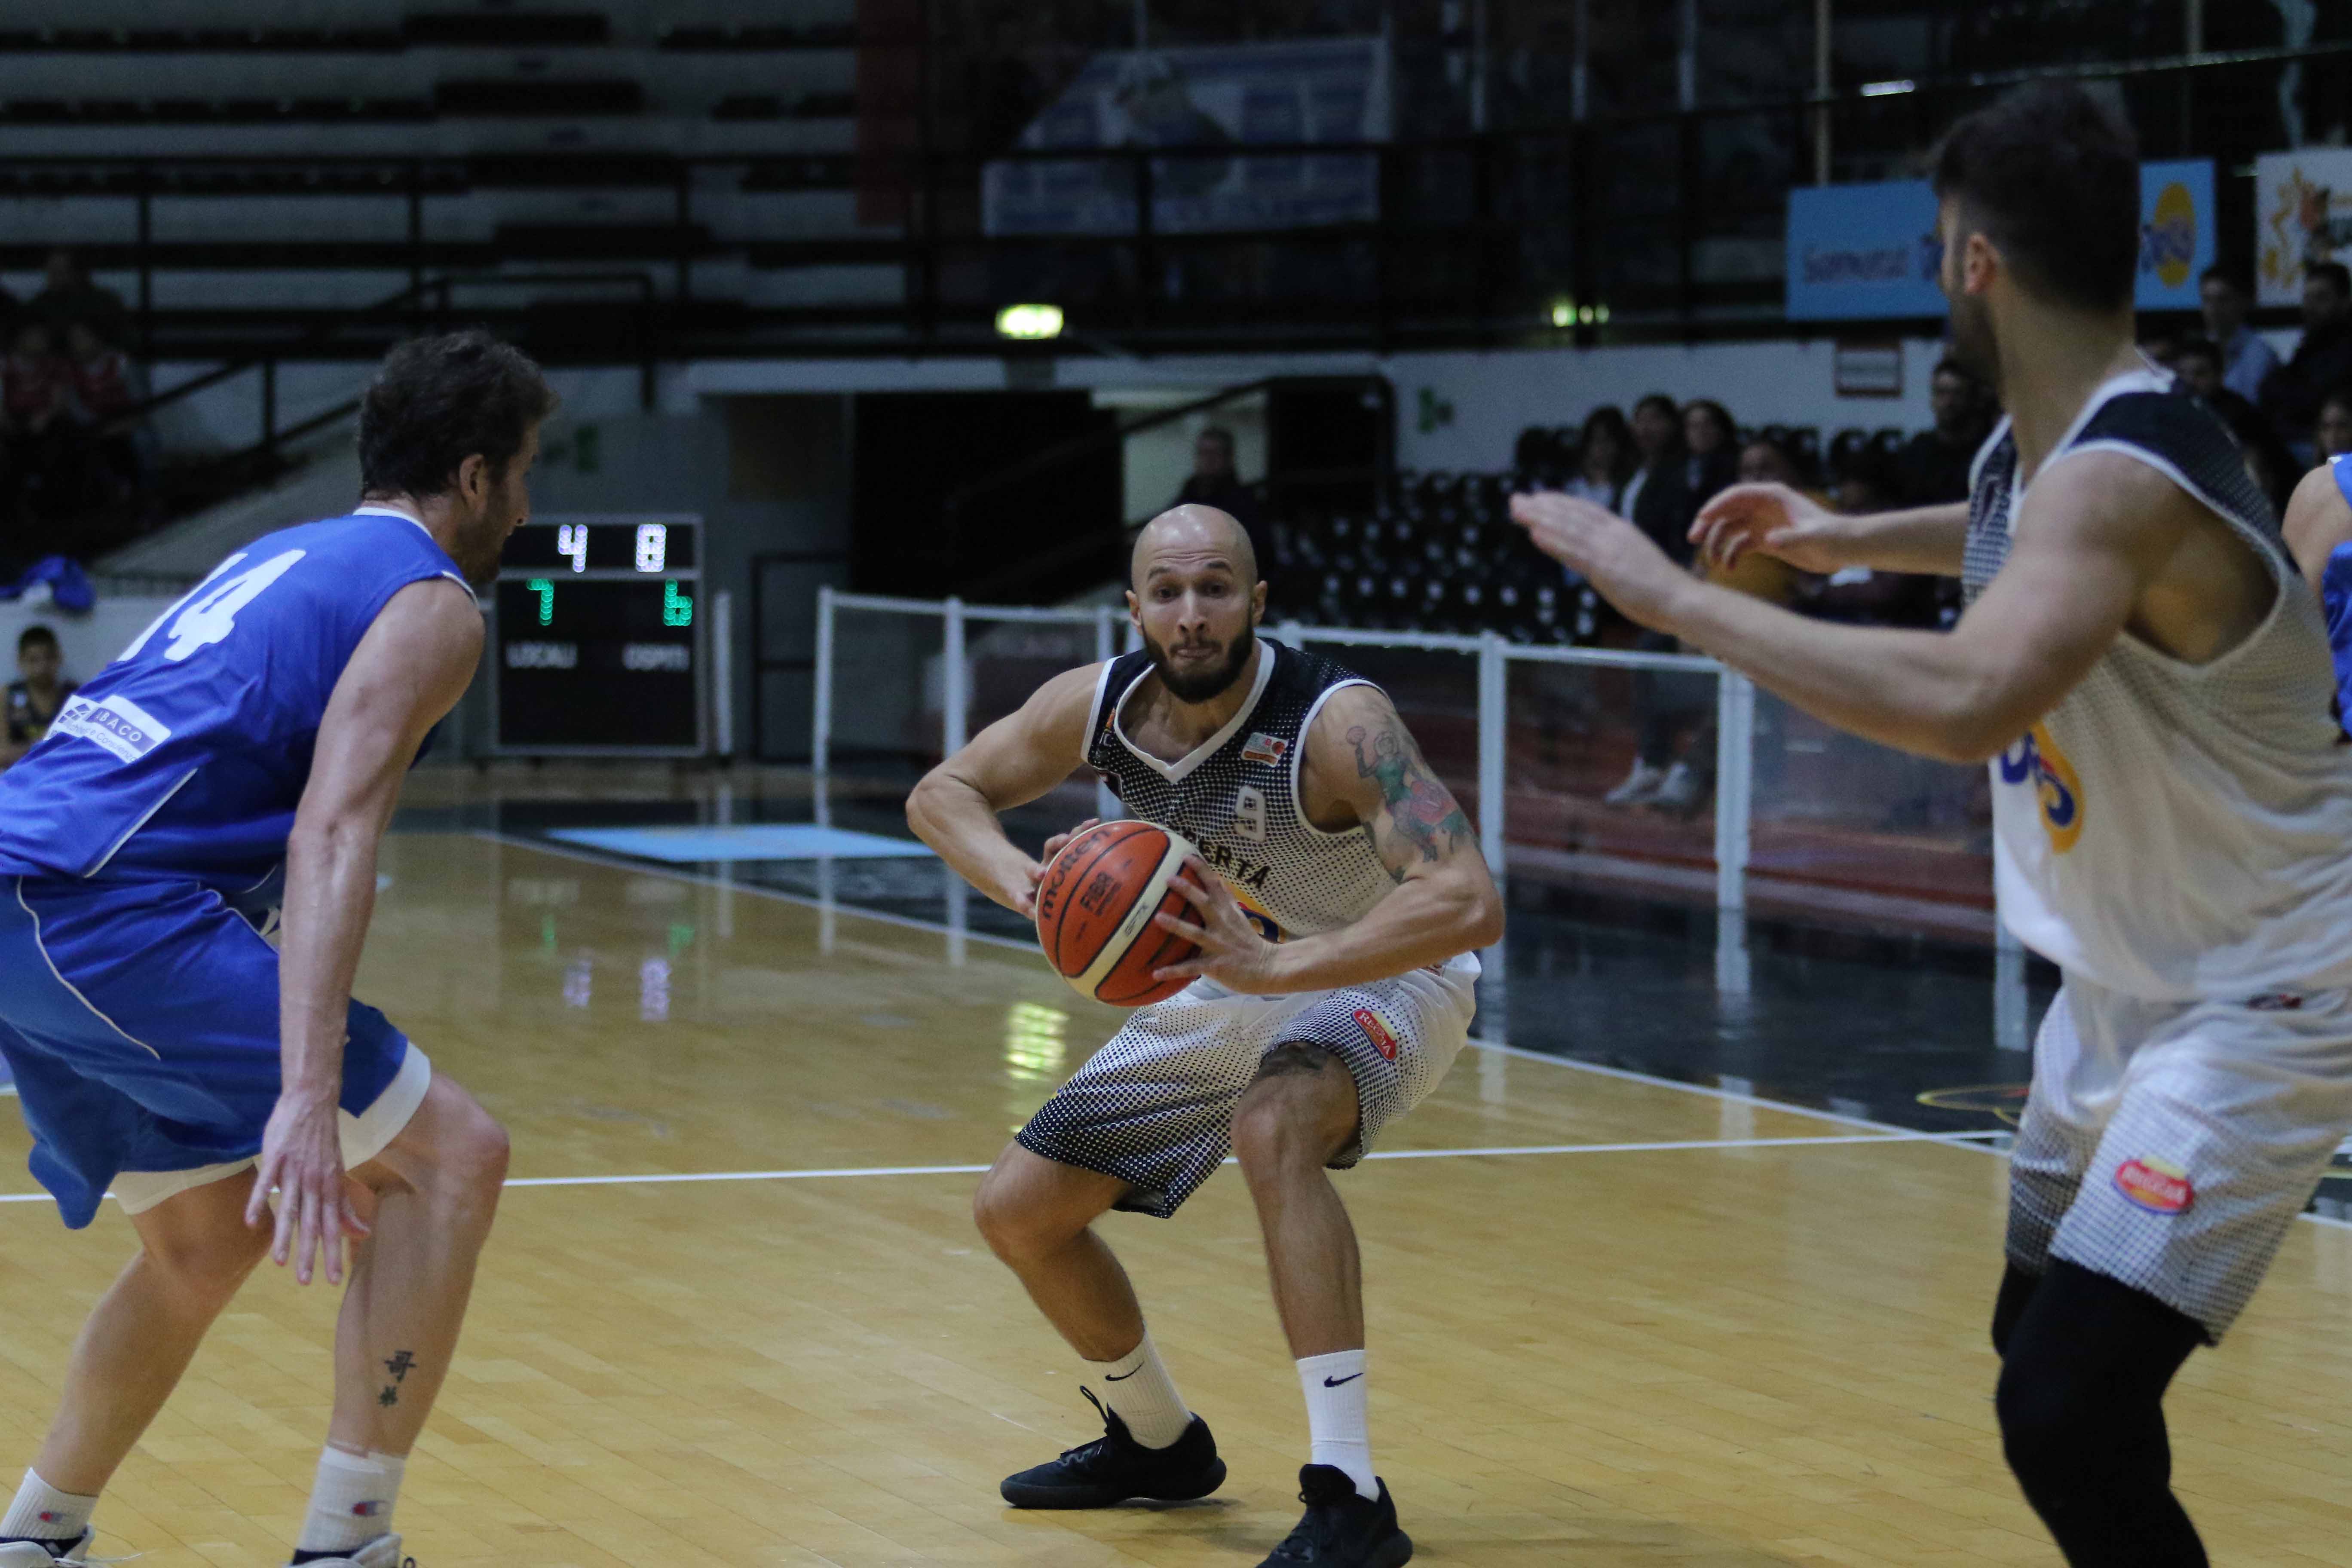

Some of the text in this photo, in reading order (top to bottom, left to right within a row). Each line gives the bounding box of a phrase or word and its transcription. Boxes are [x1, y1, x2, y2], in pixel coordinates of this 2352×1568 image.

[558, 524, 667, 573] 4 8
[116, 549, 306, 662] 14
[526, 578, 693, 626] 7 6
[1234, 785, 1266, 843] 9
[1042, 829, 1112, 919] molten
